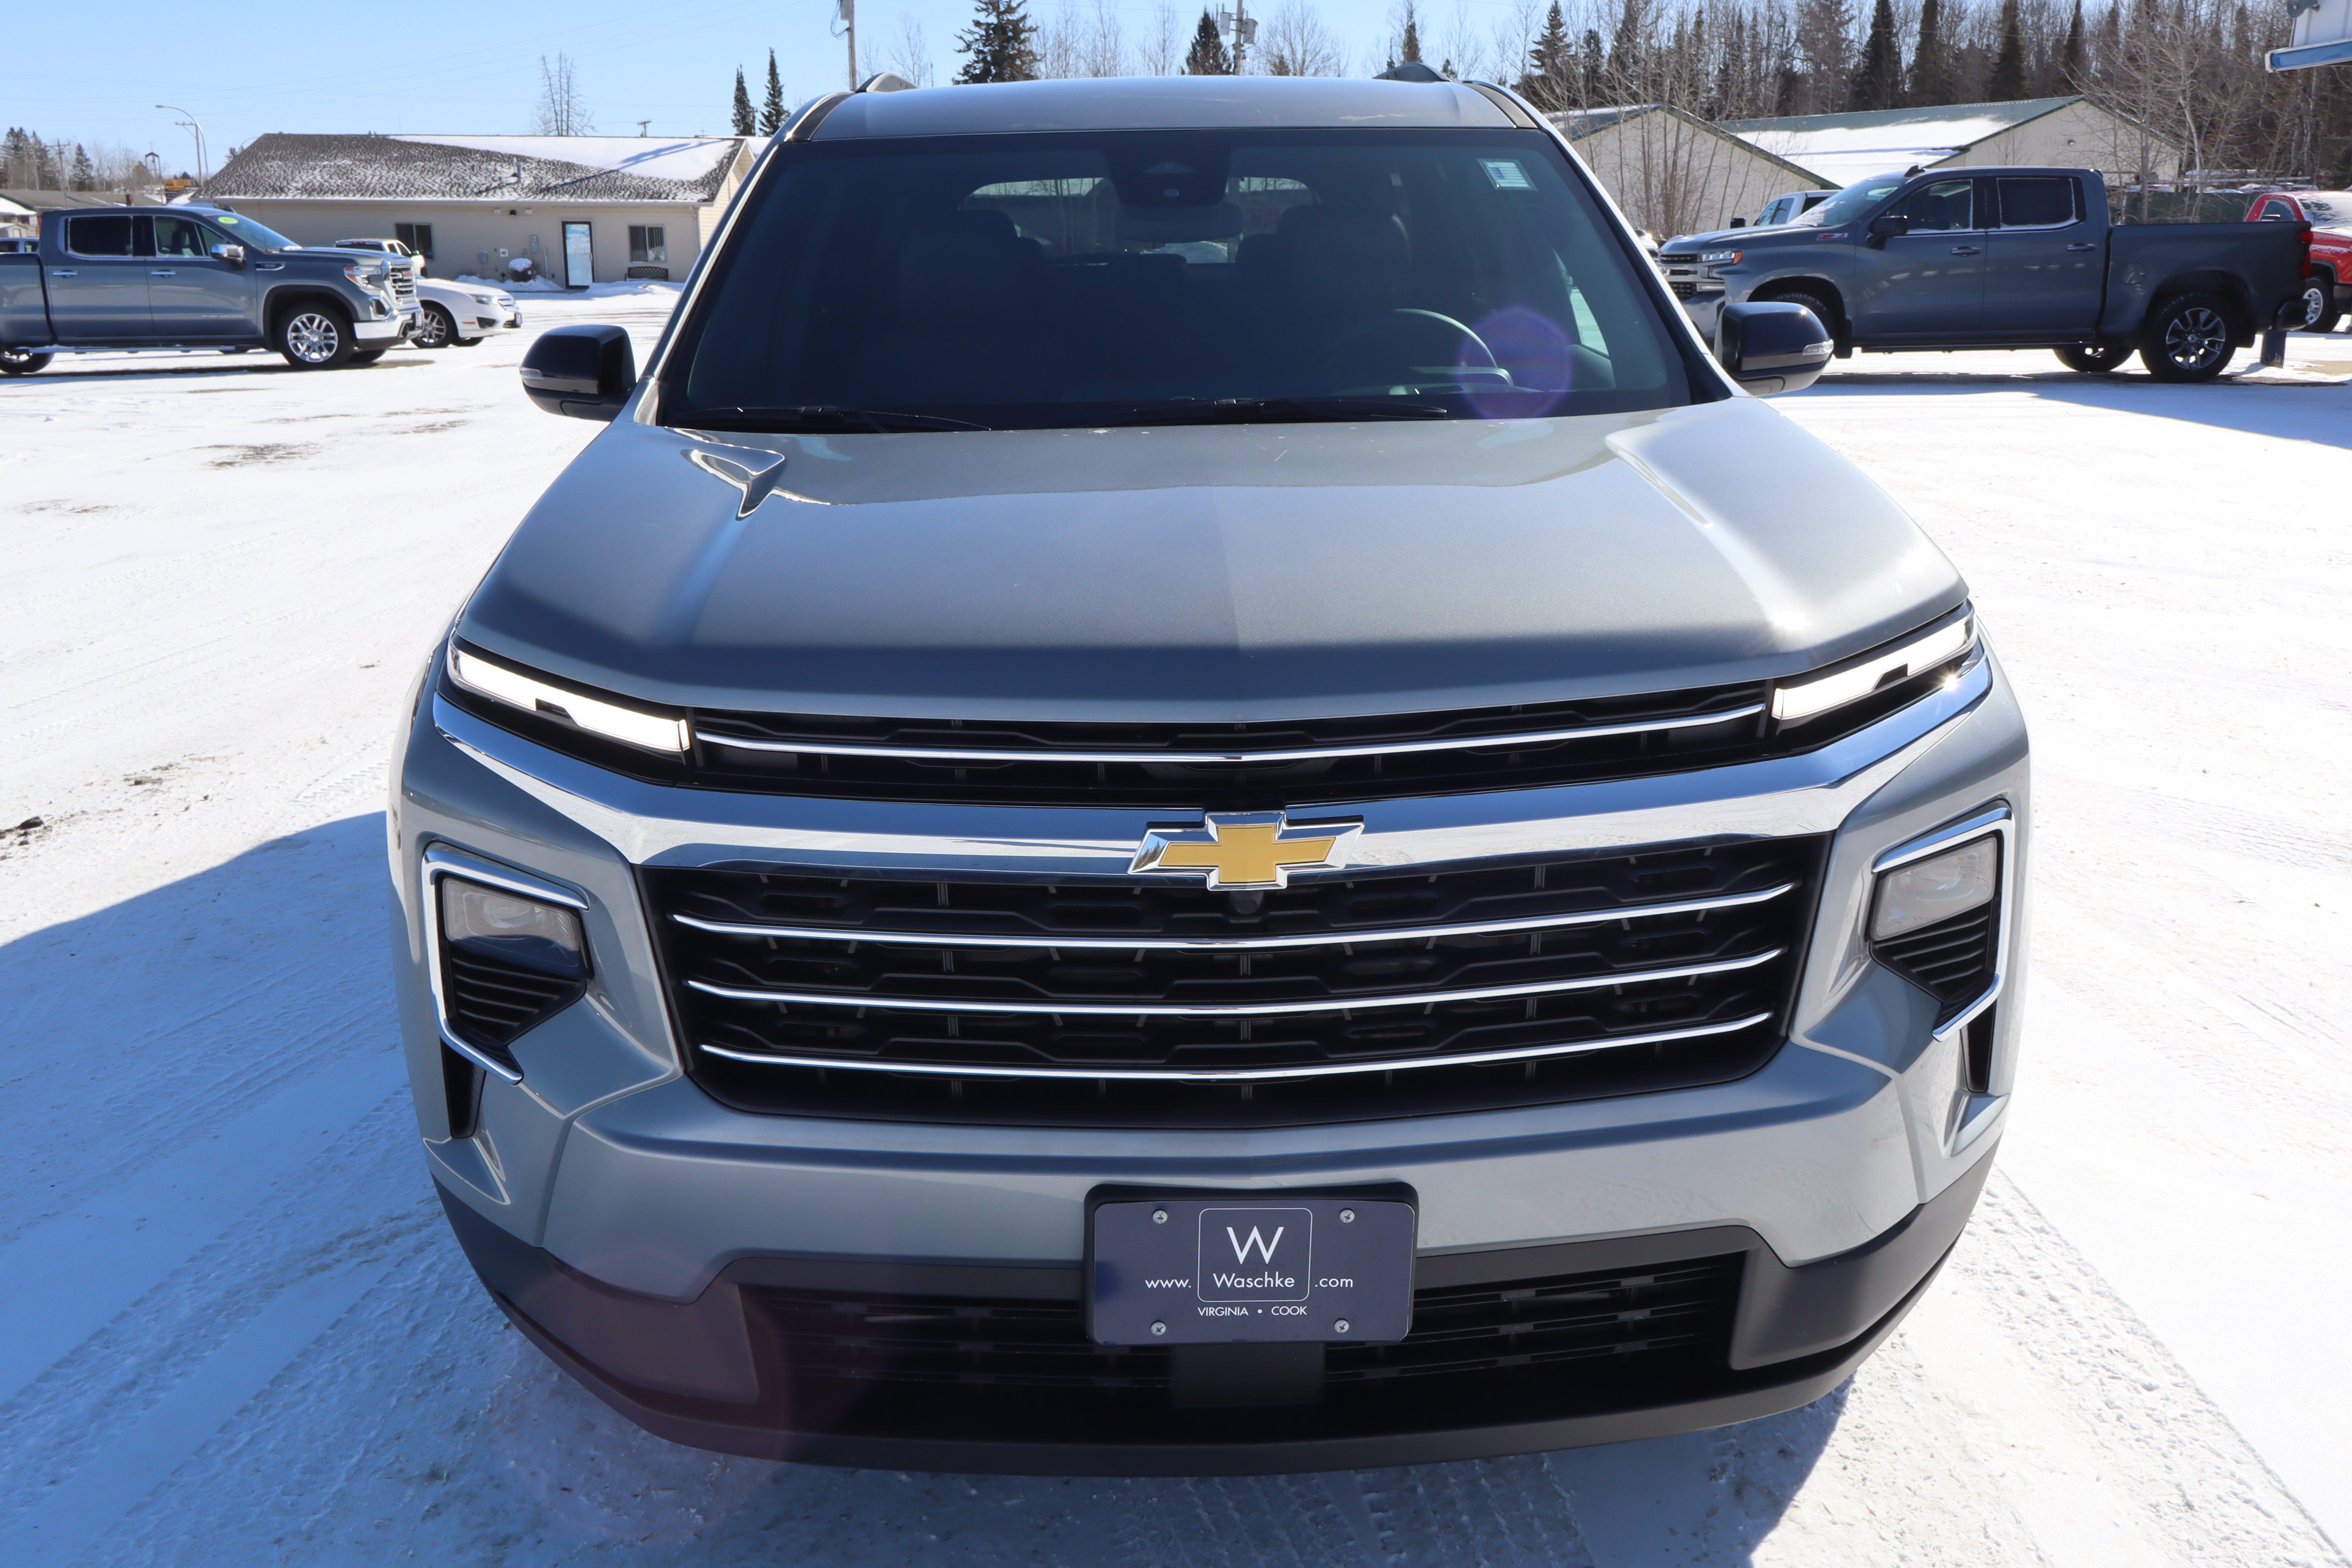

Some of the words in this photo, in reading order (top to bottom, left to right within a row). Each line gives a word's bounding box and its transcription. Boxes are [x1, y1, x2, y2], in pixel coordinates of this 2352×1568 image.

[1227, 1226, 1284, 1265] W
[1145, 1279, 1191, 1289] www.
[1213, 1271, 1295, 1288] Waschke
[1315, 1278, 1353, 1288] .com
[1198, 1307, 1249, 1316] VIRGINIA
[1271, 1306, 1308, 1316] COOK
